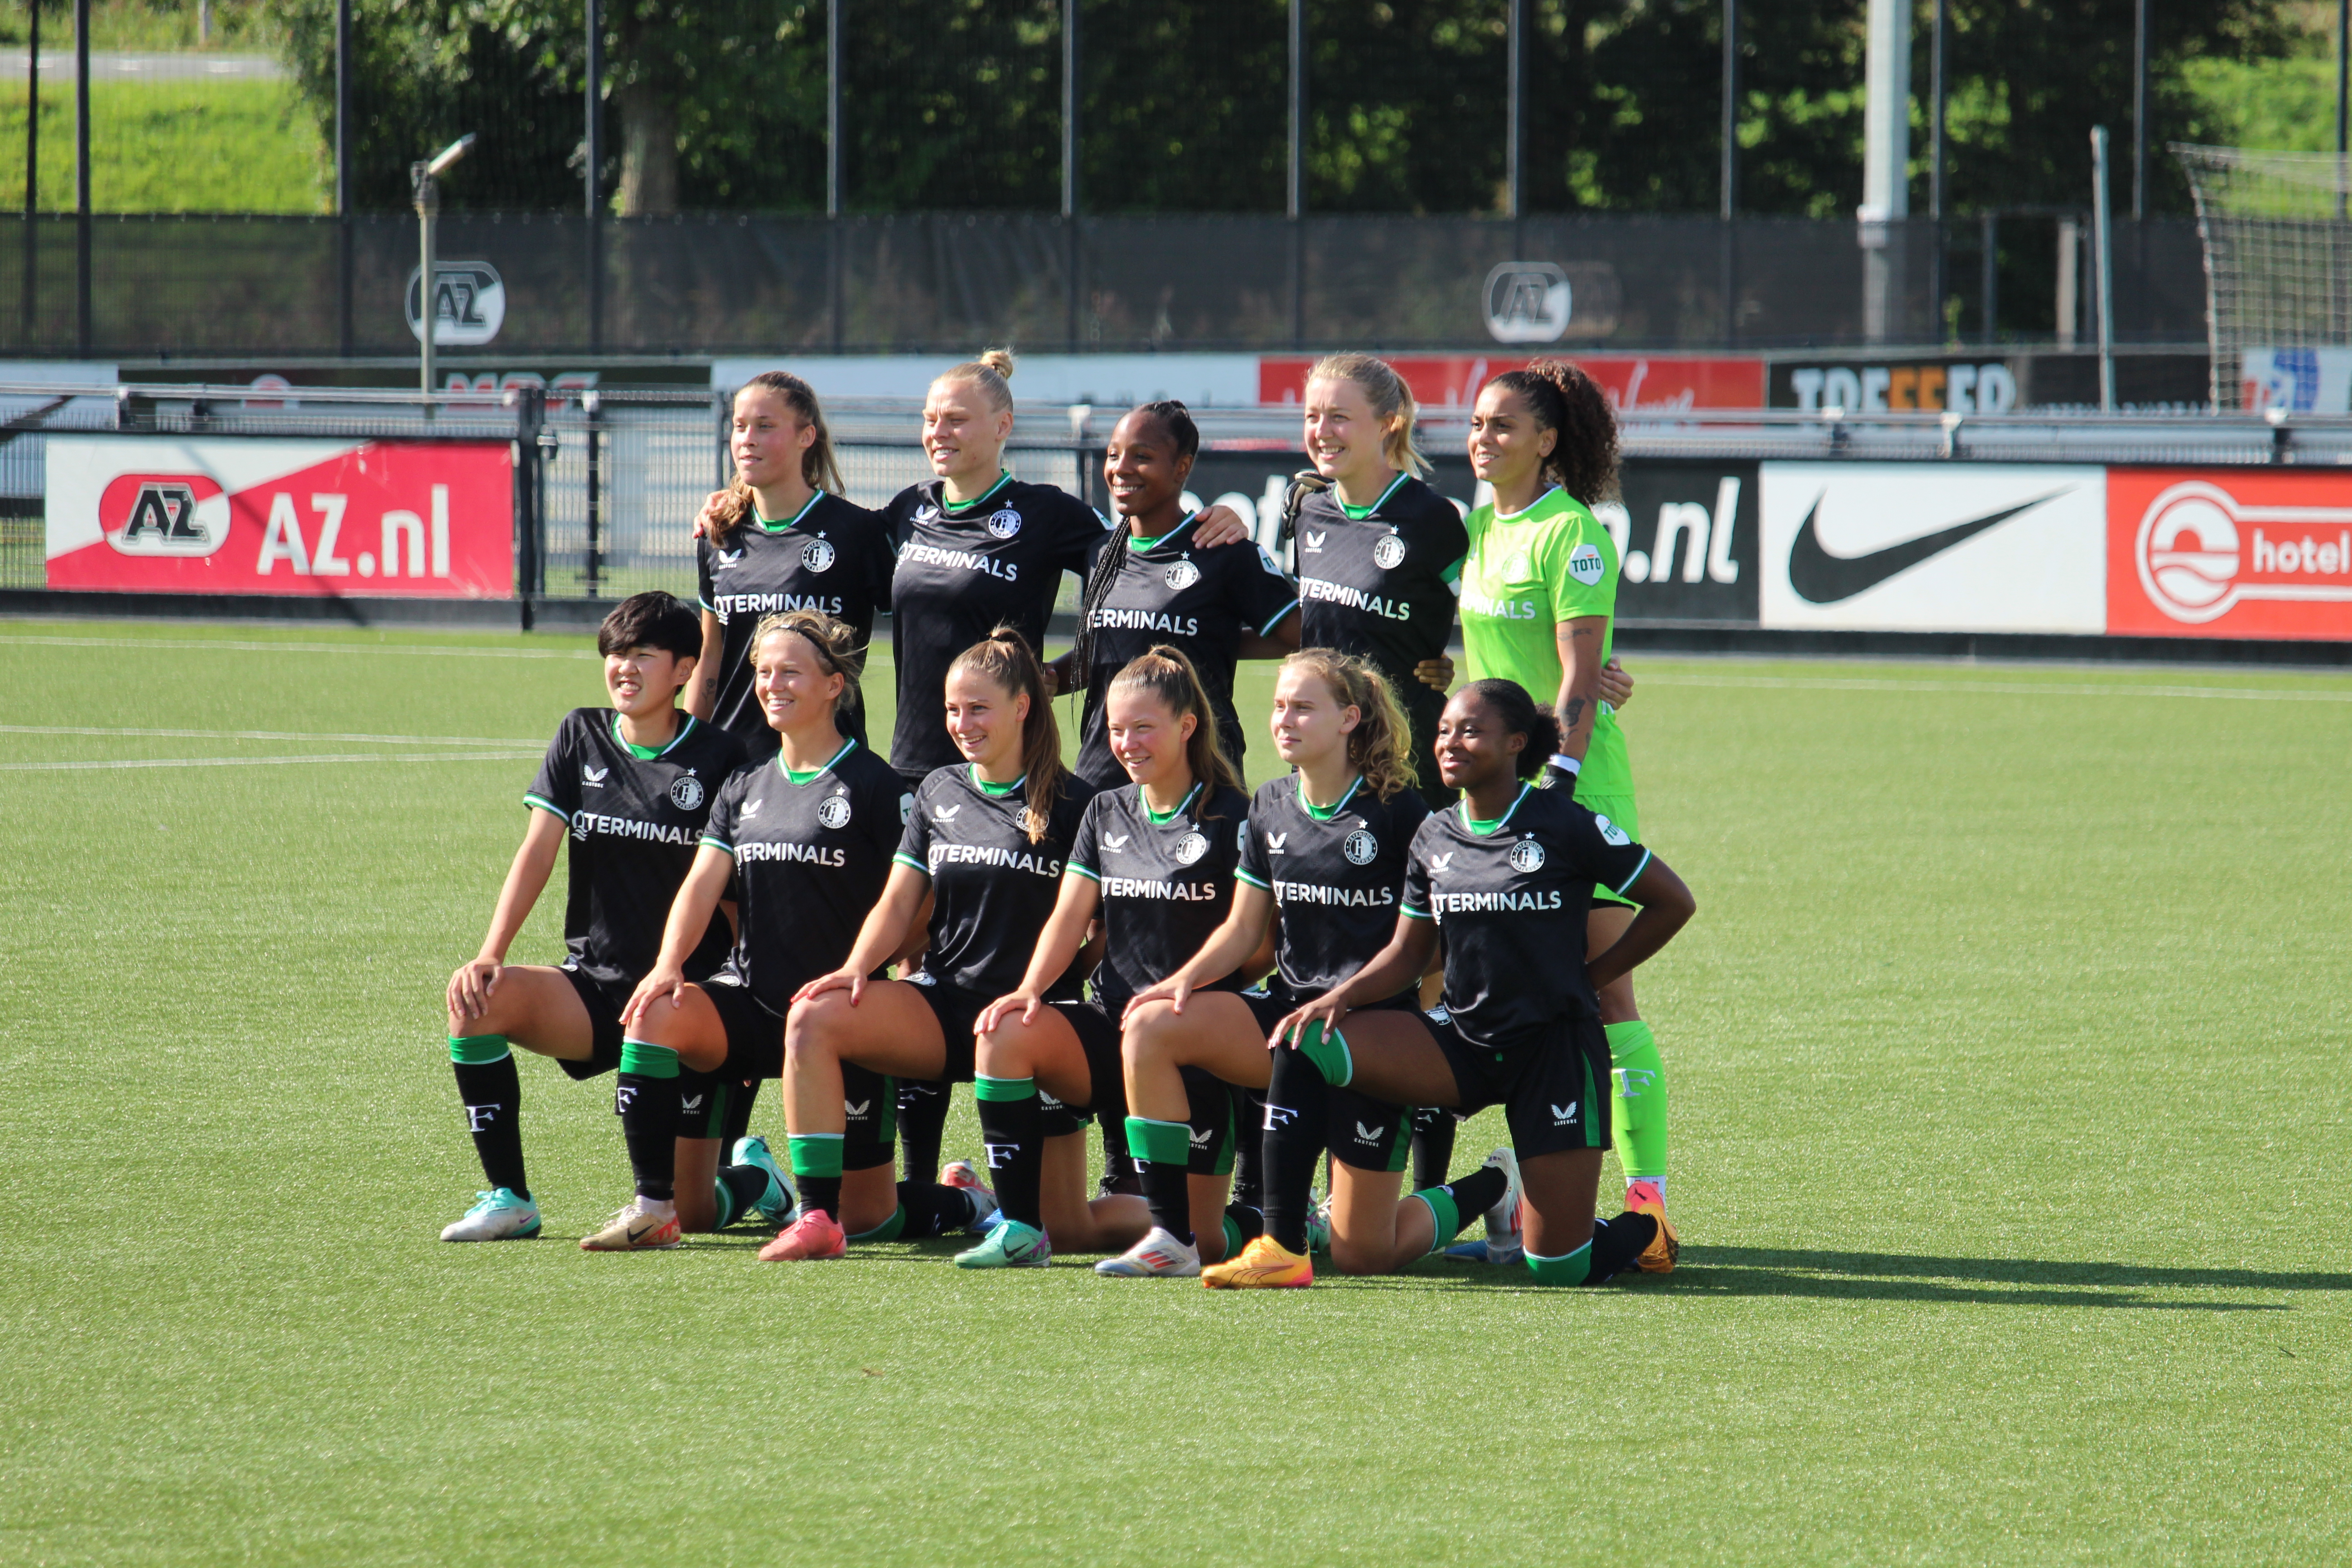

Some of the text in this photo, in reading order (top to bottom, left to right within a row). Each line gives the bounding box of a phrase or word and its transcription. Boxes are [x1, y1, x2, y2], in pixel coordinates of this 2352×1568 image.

[122, 482, 211, 545] AZ
[256, 483, 450, 578] AZ.nl
[1572, 557, 1601, 573] TOTO
[2252, 527, 2351, 574] hotel
[1612, 1068, 1656, 1098] F
[466, 1103, 500, 1132] F
[1263, 1104, 1298, 1131] F
[984, 1143, 1020, 1169] F
[1354, 1137, 1379, 1147] CASTORE
